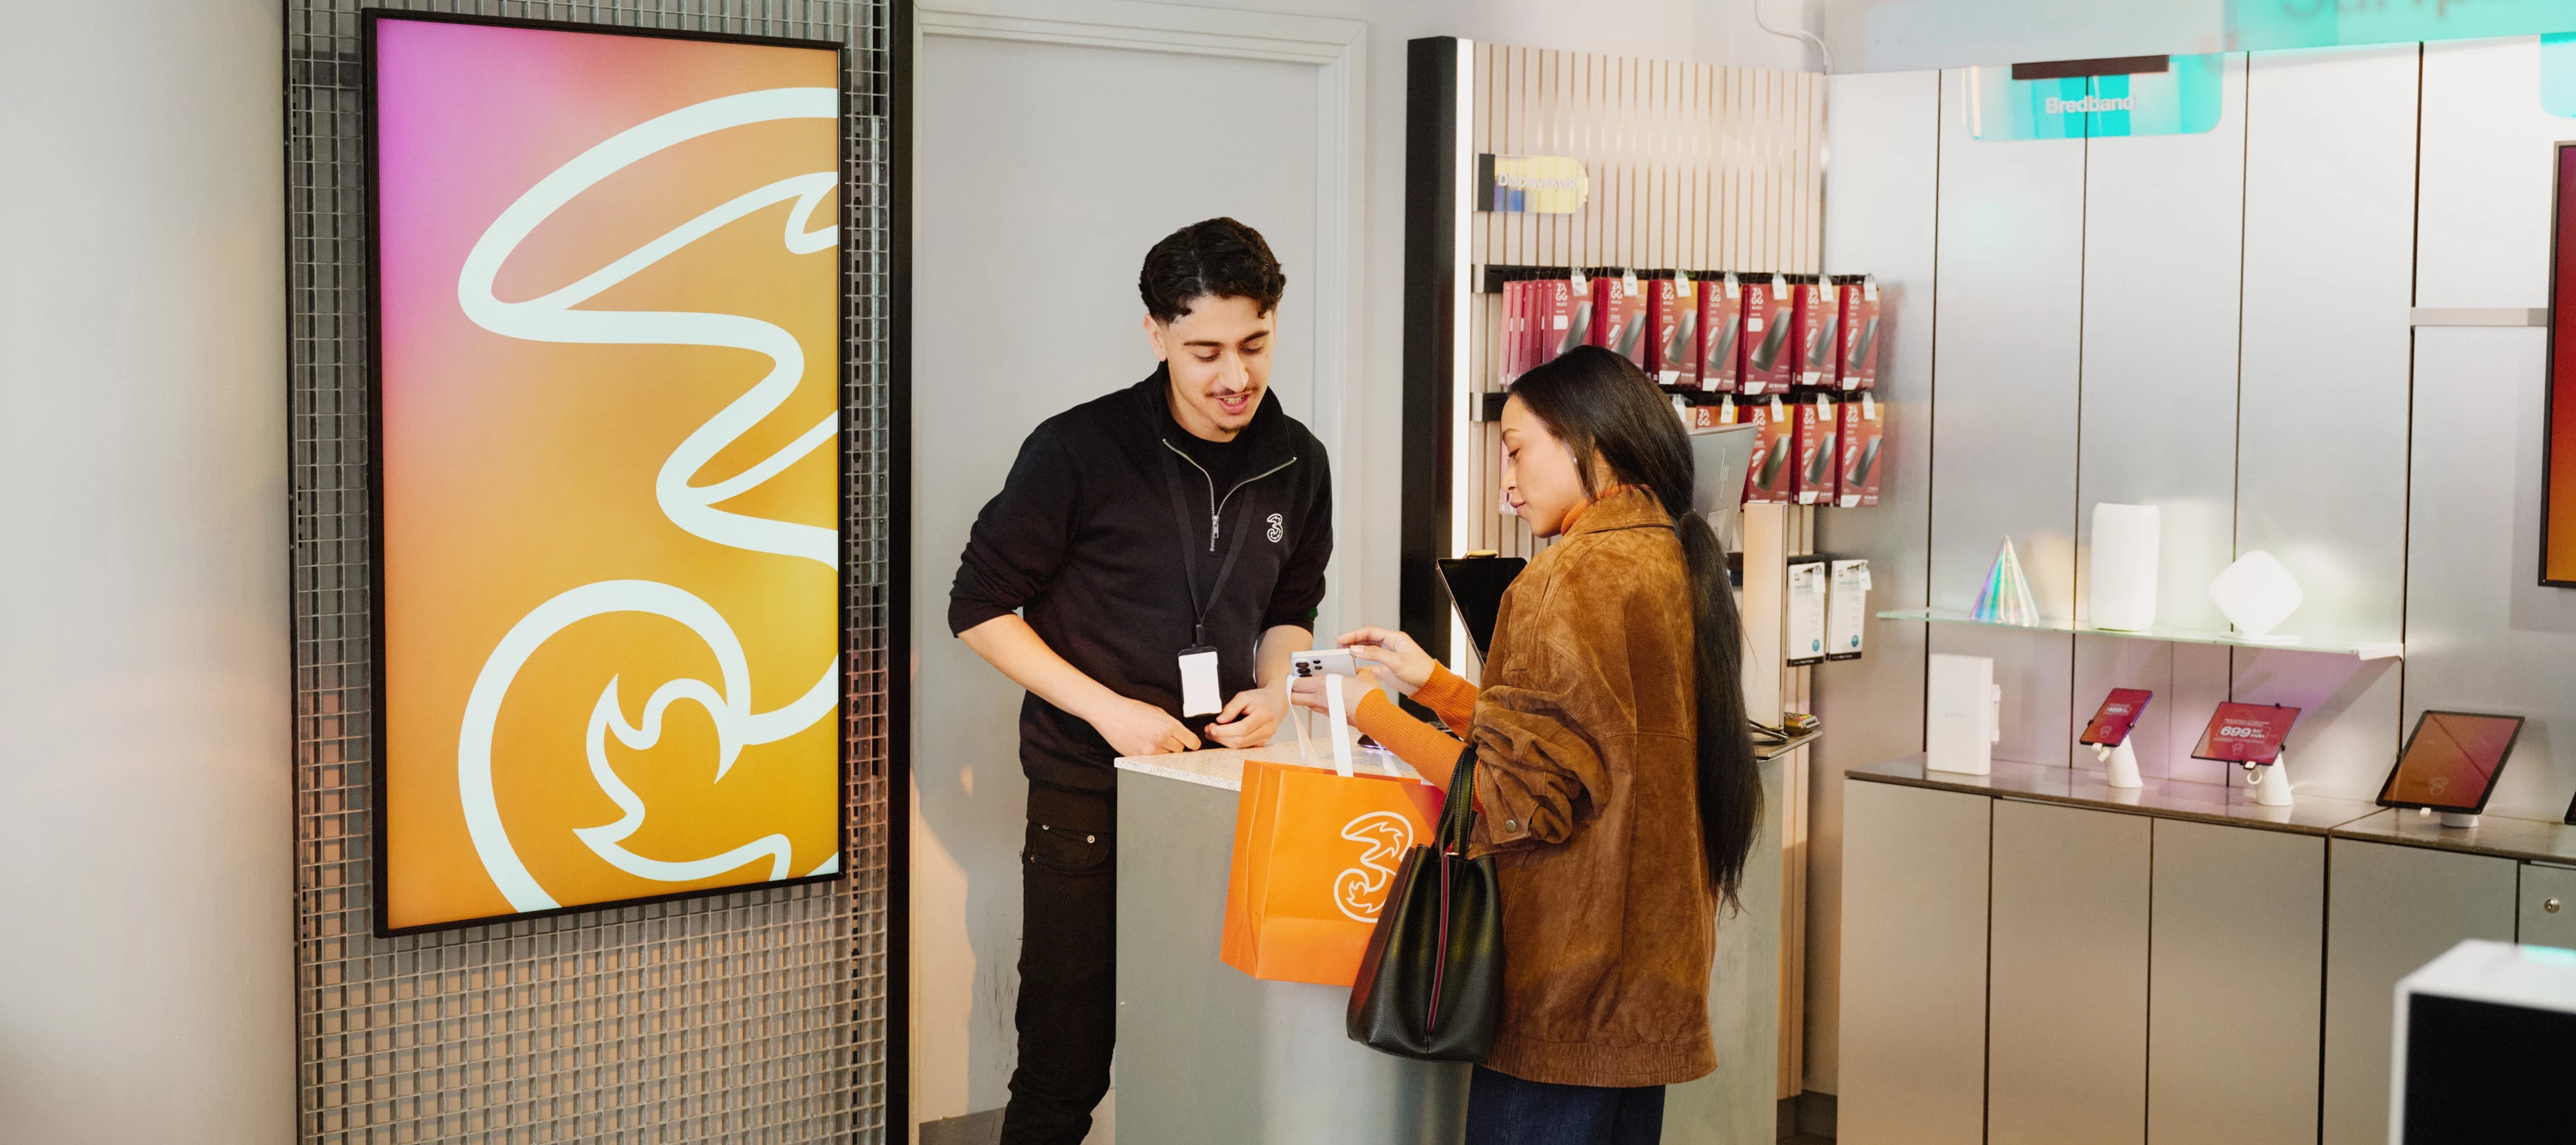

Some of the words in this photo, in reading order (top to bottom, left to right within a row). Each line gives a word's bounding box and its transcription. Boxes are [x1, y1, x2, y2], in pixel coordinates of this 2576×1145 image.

[2045, 94, 2136, 114] Bredband
[1267, 513, 1283, 542] 3
[2221, 726, 2251, 738] 699
[1334, 811, 1413, 923] 3
